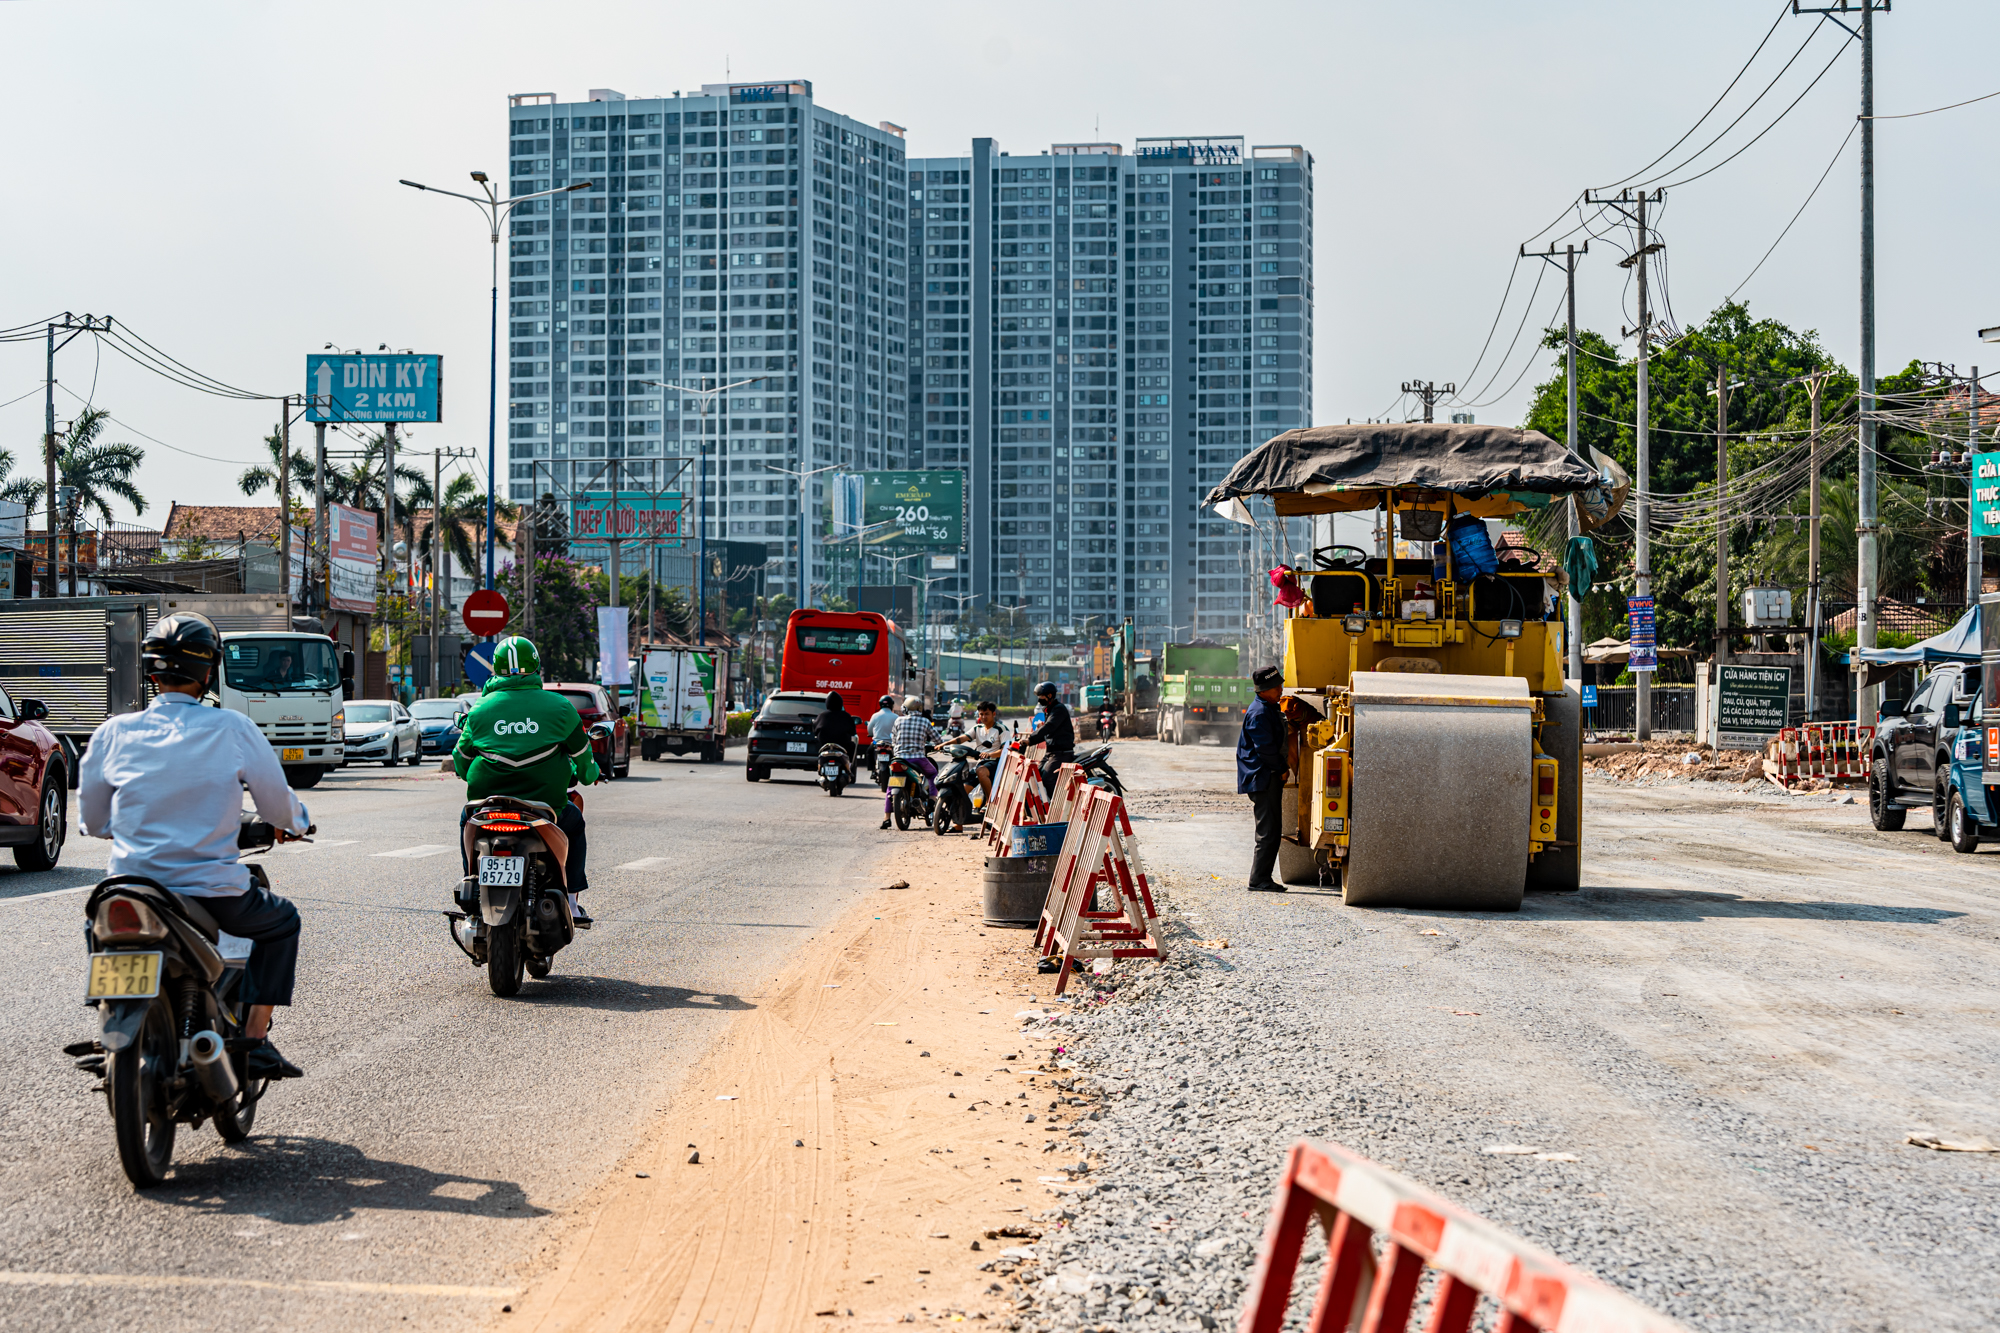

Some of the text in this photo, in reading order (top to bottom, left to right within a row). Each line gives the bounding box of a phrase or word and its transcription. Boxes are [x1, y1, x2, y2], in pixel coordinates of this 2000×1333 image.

[740, 87, 774, 102] HKK
[1140, 144, 1239, 159] THE RIVANA
[343, 357, 428, 388] DÌN KÝ
[355, 392, 416, 407] 2 KM
[416, 411, 427, 419] 42
[1978, 458, 1998, 478] CỬA
[1976, 485, 2000, 505] THỰC
[576, 504, 602, 534] THÉP
[895, 506, 929, 522] 260
[905, 524, 926, 535] NHÀ
[1724, 668, 1785, 683] CỬA HÀNG TIỆN ÍCH
[816, 680, 853, 689] 50F-020.47
[494, 718, 539, 735] Grab
[487, 859, 516, 871] 95-E1
[482, 872, 520, 884] 857.29
